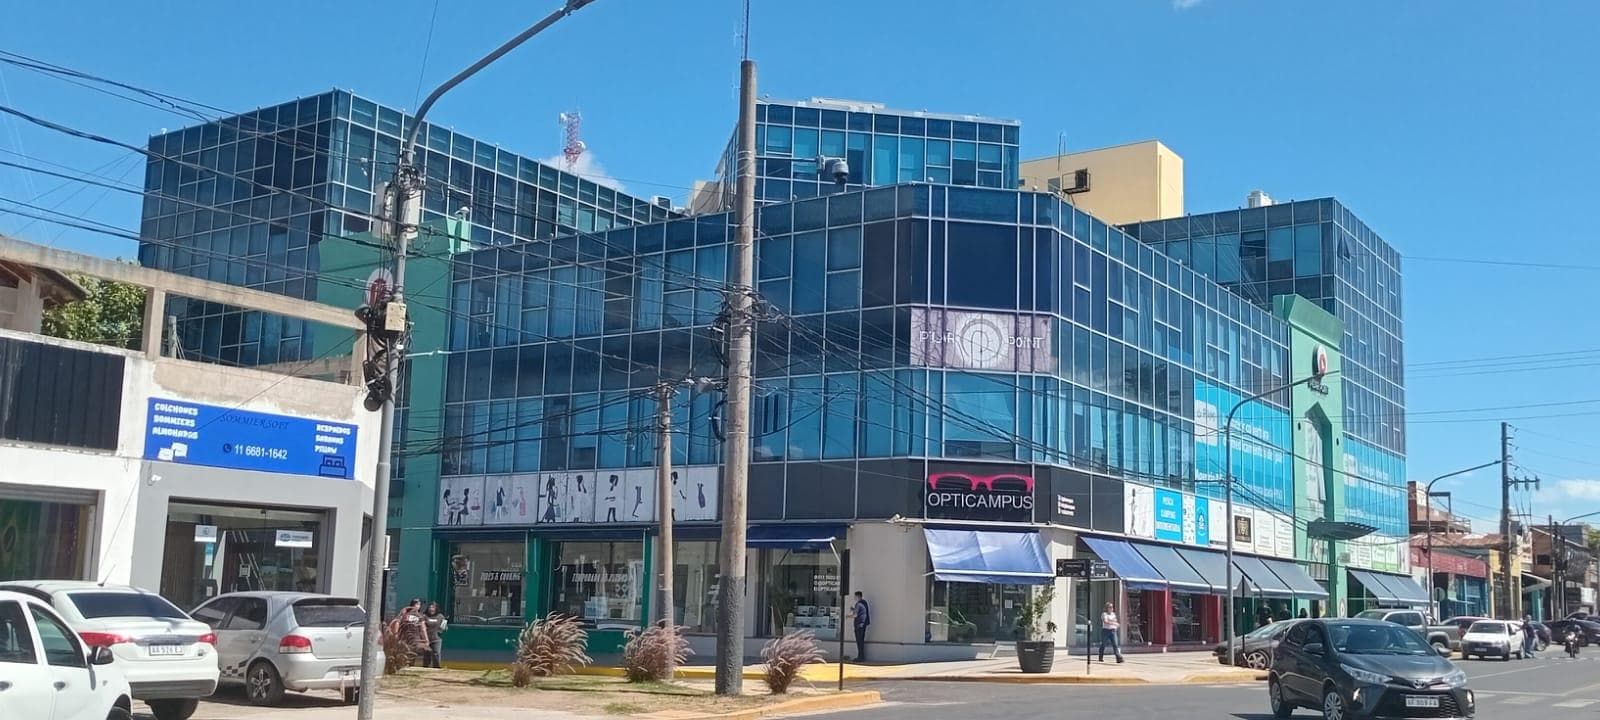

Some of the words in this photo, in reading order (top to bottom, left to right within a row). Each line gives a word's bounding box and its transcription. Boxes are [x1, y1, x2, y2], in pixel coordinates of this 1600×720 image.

[154, 402, 198, 416] COLCHONES
[153, 414, 195, 427] SOMMIERS
[152, 426, 198, 439] ALMOHADAS
[234, 443, 243, 456] 11
[245, 445, 288, 460] 6681-1642
[927, 492, 1033, 510] OPTICAMPUS
